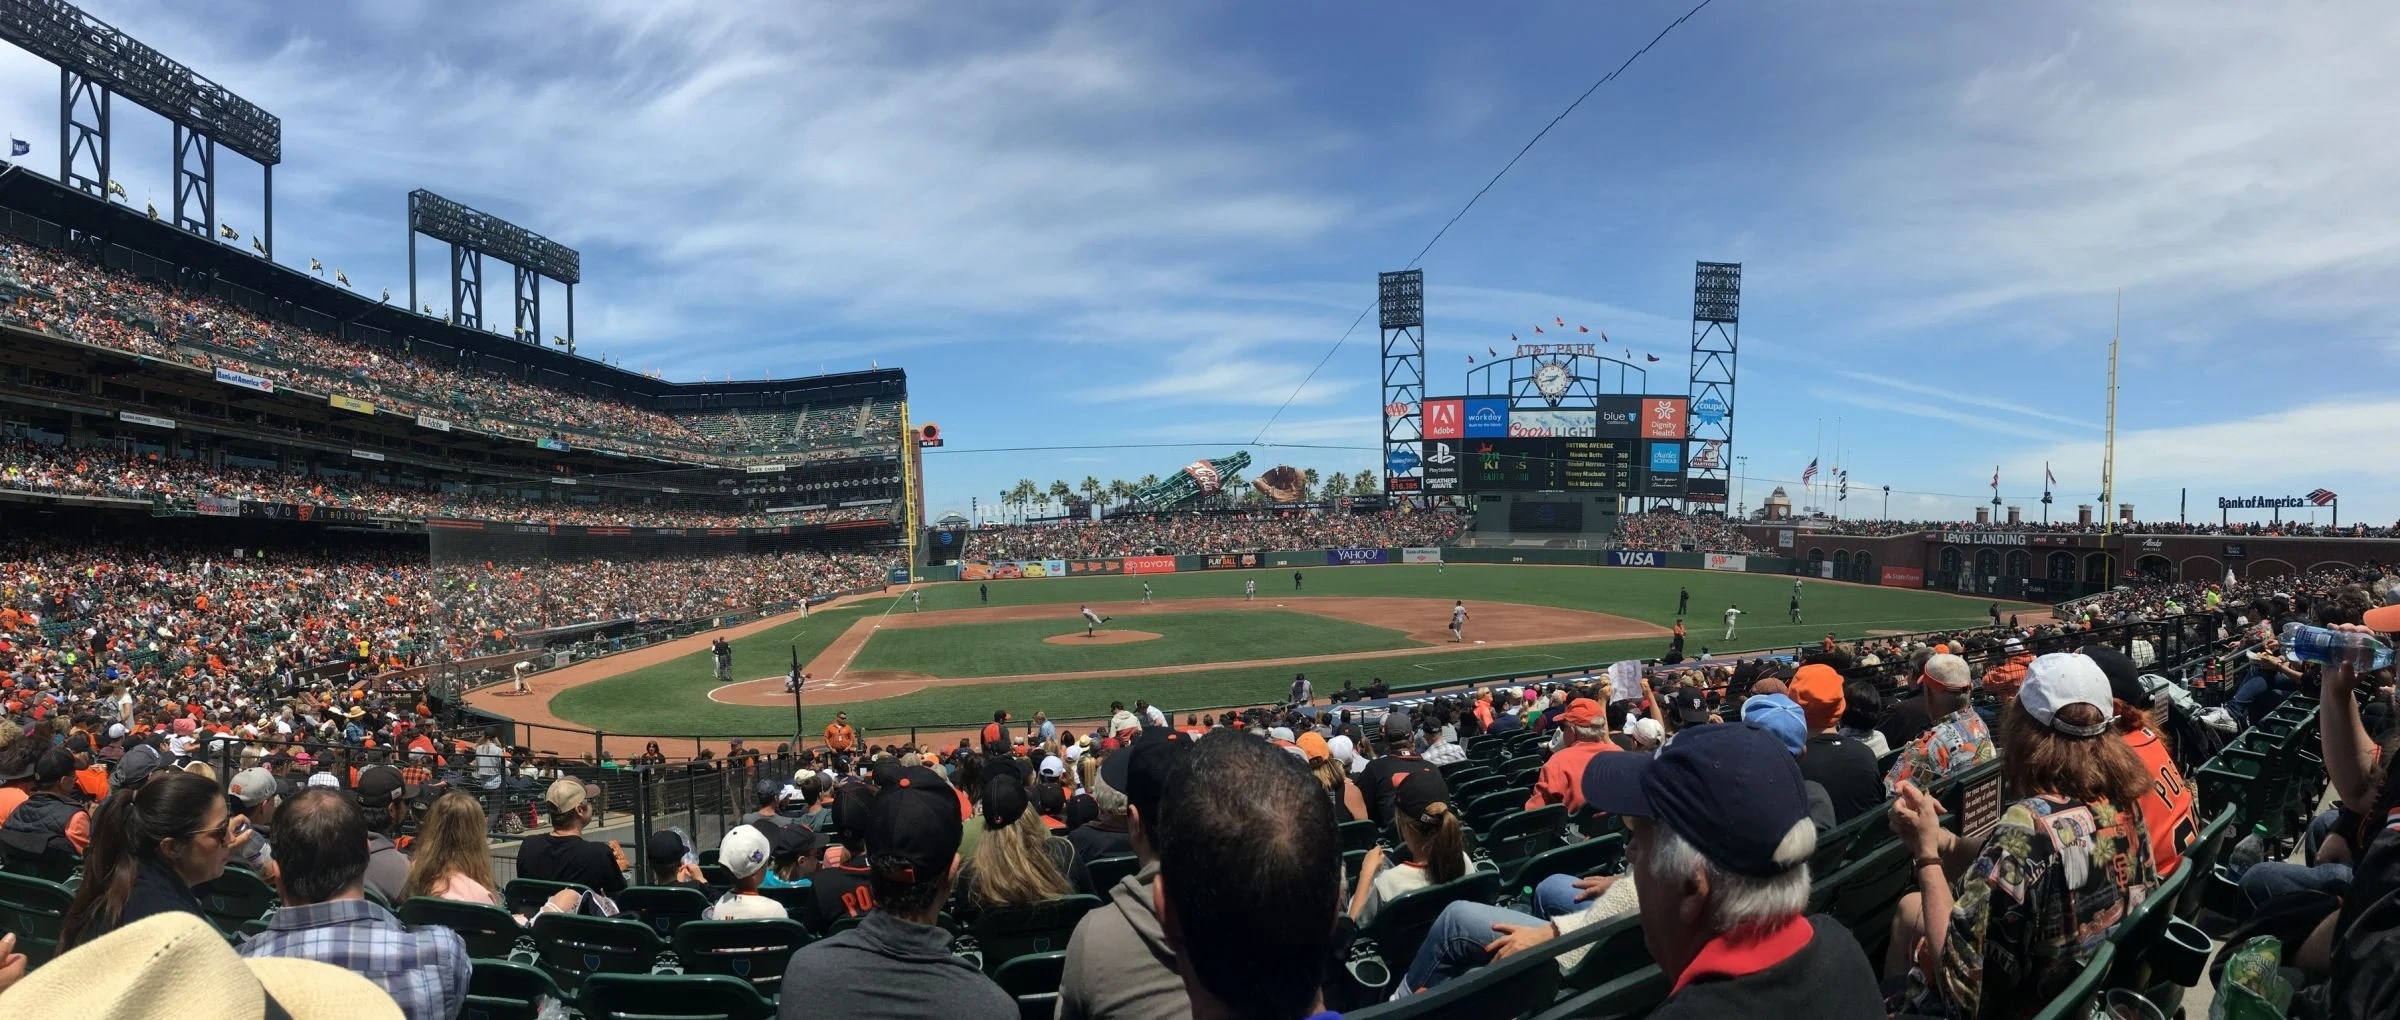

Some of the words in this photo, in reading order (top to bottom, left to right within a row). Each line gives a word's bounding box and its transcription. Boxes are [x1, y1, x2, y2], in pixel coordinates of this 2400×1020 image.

[1516, 344, 1549, 357] AT&T
[1556, 344, 1596, 356] PARK
[217, 371, 232, 381] Bank
[232, 374, 238, 382] of
[238, 376, 260, 386] America
[1387, 403, 1406, 416] AAA
[1700, 403, 1722, 412] coupa
[1468, 413, 1502, 422] workday
[1604, 412, 1626, 420] blue
[428, 420, 444, 430] Adobe
[1433, 426, 1455, 434] Adobe
[1508, 422, 1552, 437] Coors
[1555, 427, 1596, 437] LIGHT
[1652, 422, 1676, 431] Dignity
[2218, 496, 2245, 508] Bank
[2245, 496, 2256, 508] of
[2256, 495, 2304, 508] America
[219, 505, 238, 513] LIGHT
[243, 504, 248, 514] 3
[285, 506, 290, 517] 0
[1974, 534, 2026, 545] LANDING
[2142, 538, 2162, 547] Alaska
[1338, 550, 1378, 560] YAHOO!
[1616, 552, 1654, 566] VISA
[1712, 556, 1726, 564] AAA
[1140, 560, 1174, 568] TOYOTA
[842, 886, 876, 918] PO
